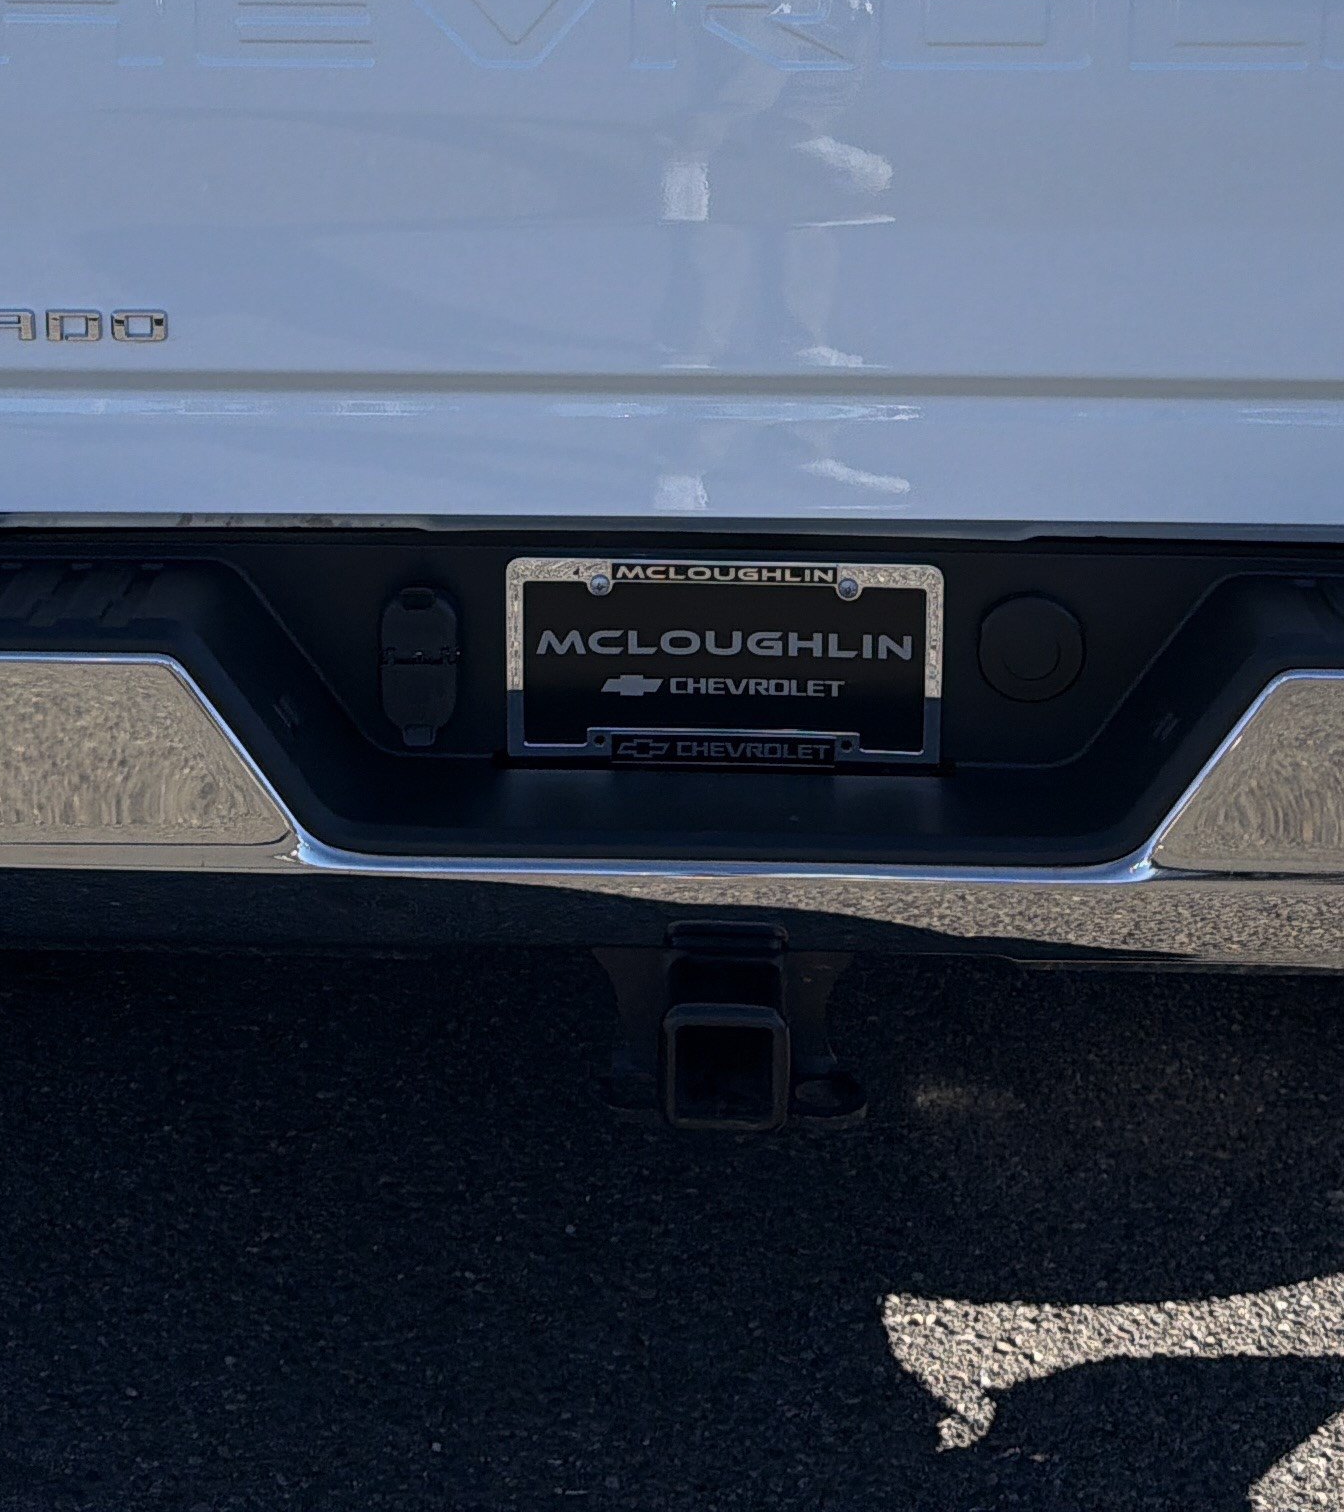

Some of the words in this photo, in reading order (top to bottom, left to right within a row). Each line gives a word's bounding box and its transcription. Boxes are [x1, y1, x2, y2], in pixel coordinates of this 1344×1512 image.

[615, 564, 835, 583] MCLOUGHLIN
[535, 629, 913, 660] MCLOUGHLIN
[669, 677, 846, 697] CHEVROLET
[675, 740, 831, 761] CHEVROLET
